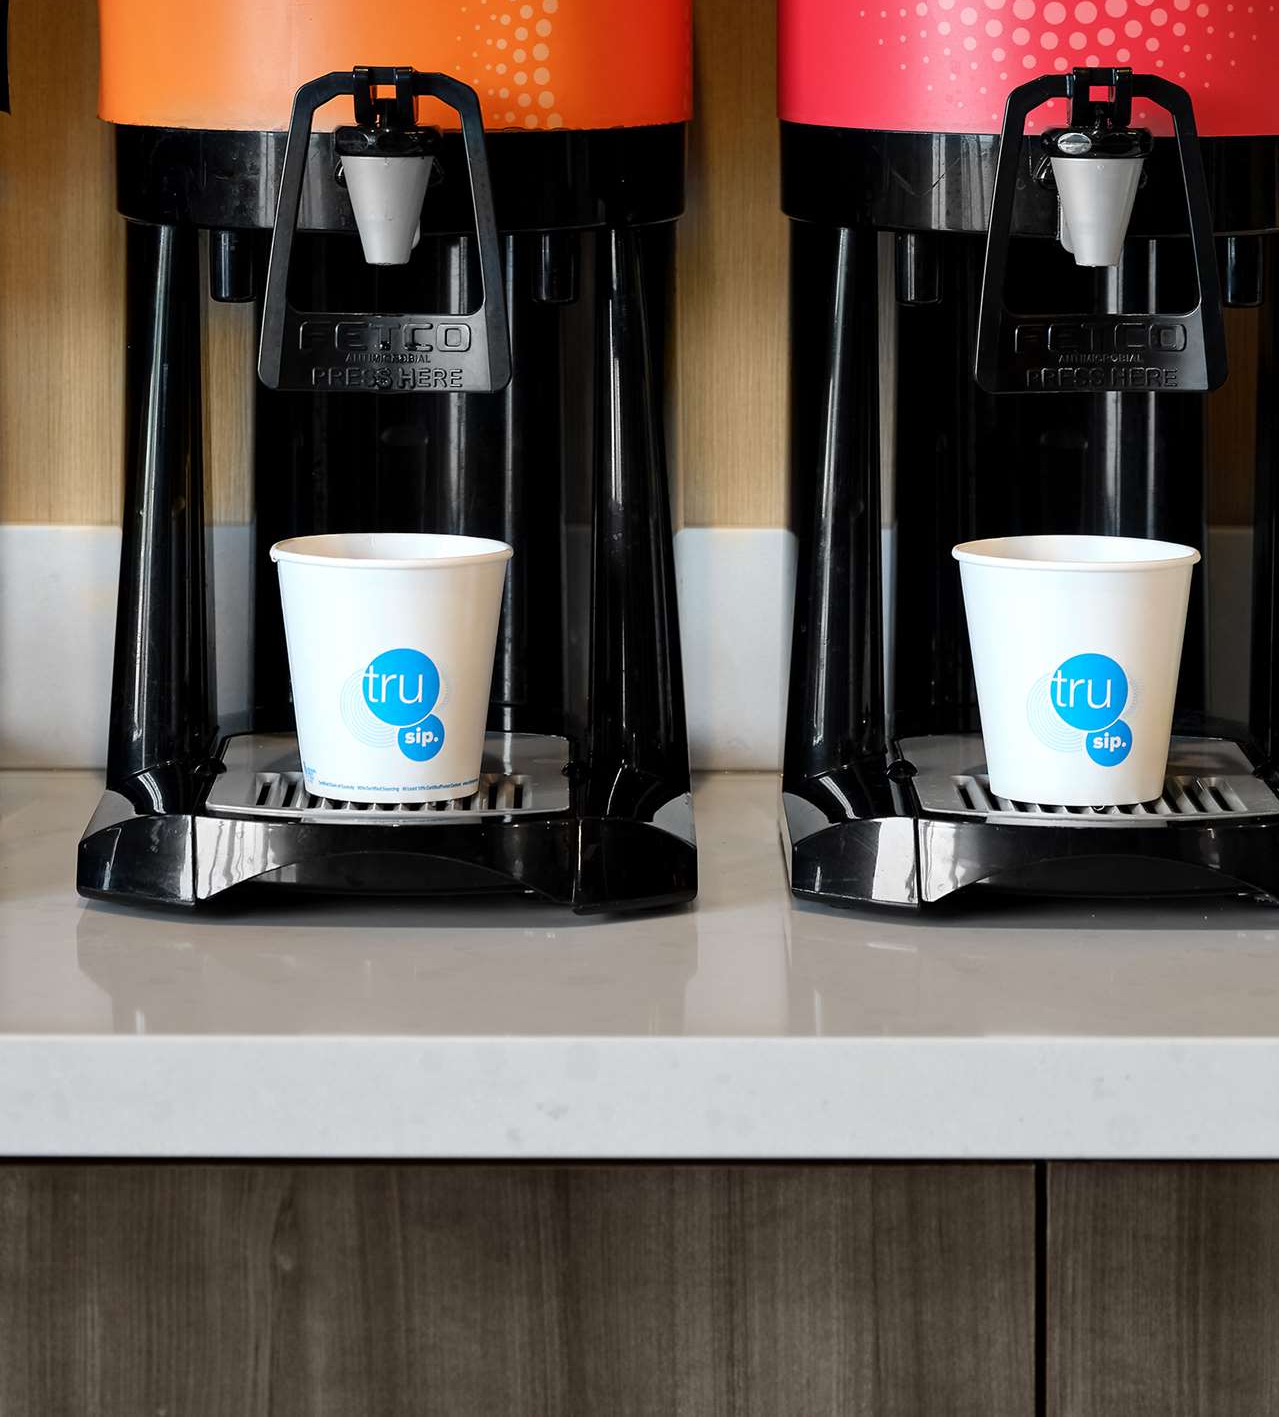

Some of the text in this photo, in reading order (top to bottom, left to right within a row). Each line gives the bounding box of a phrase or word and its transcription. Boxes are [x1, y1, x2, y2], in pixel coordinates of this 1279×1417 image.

[299, 321, 471, 352] FETCO
[311, 367, 463, 389] PRESS HERE
[1111, 367, 1178, 387] HERE
[363, 665, 423, 703] tru
[1051, 670, 1111, 709] tru
[405, 727, 438, 747] sip.
[1093, 732, 1126, 752] sip.
